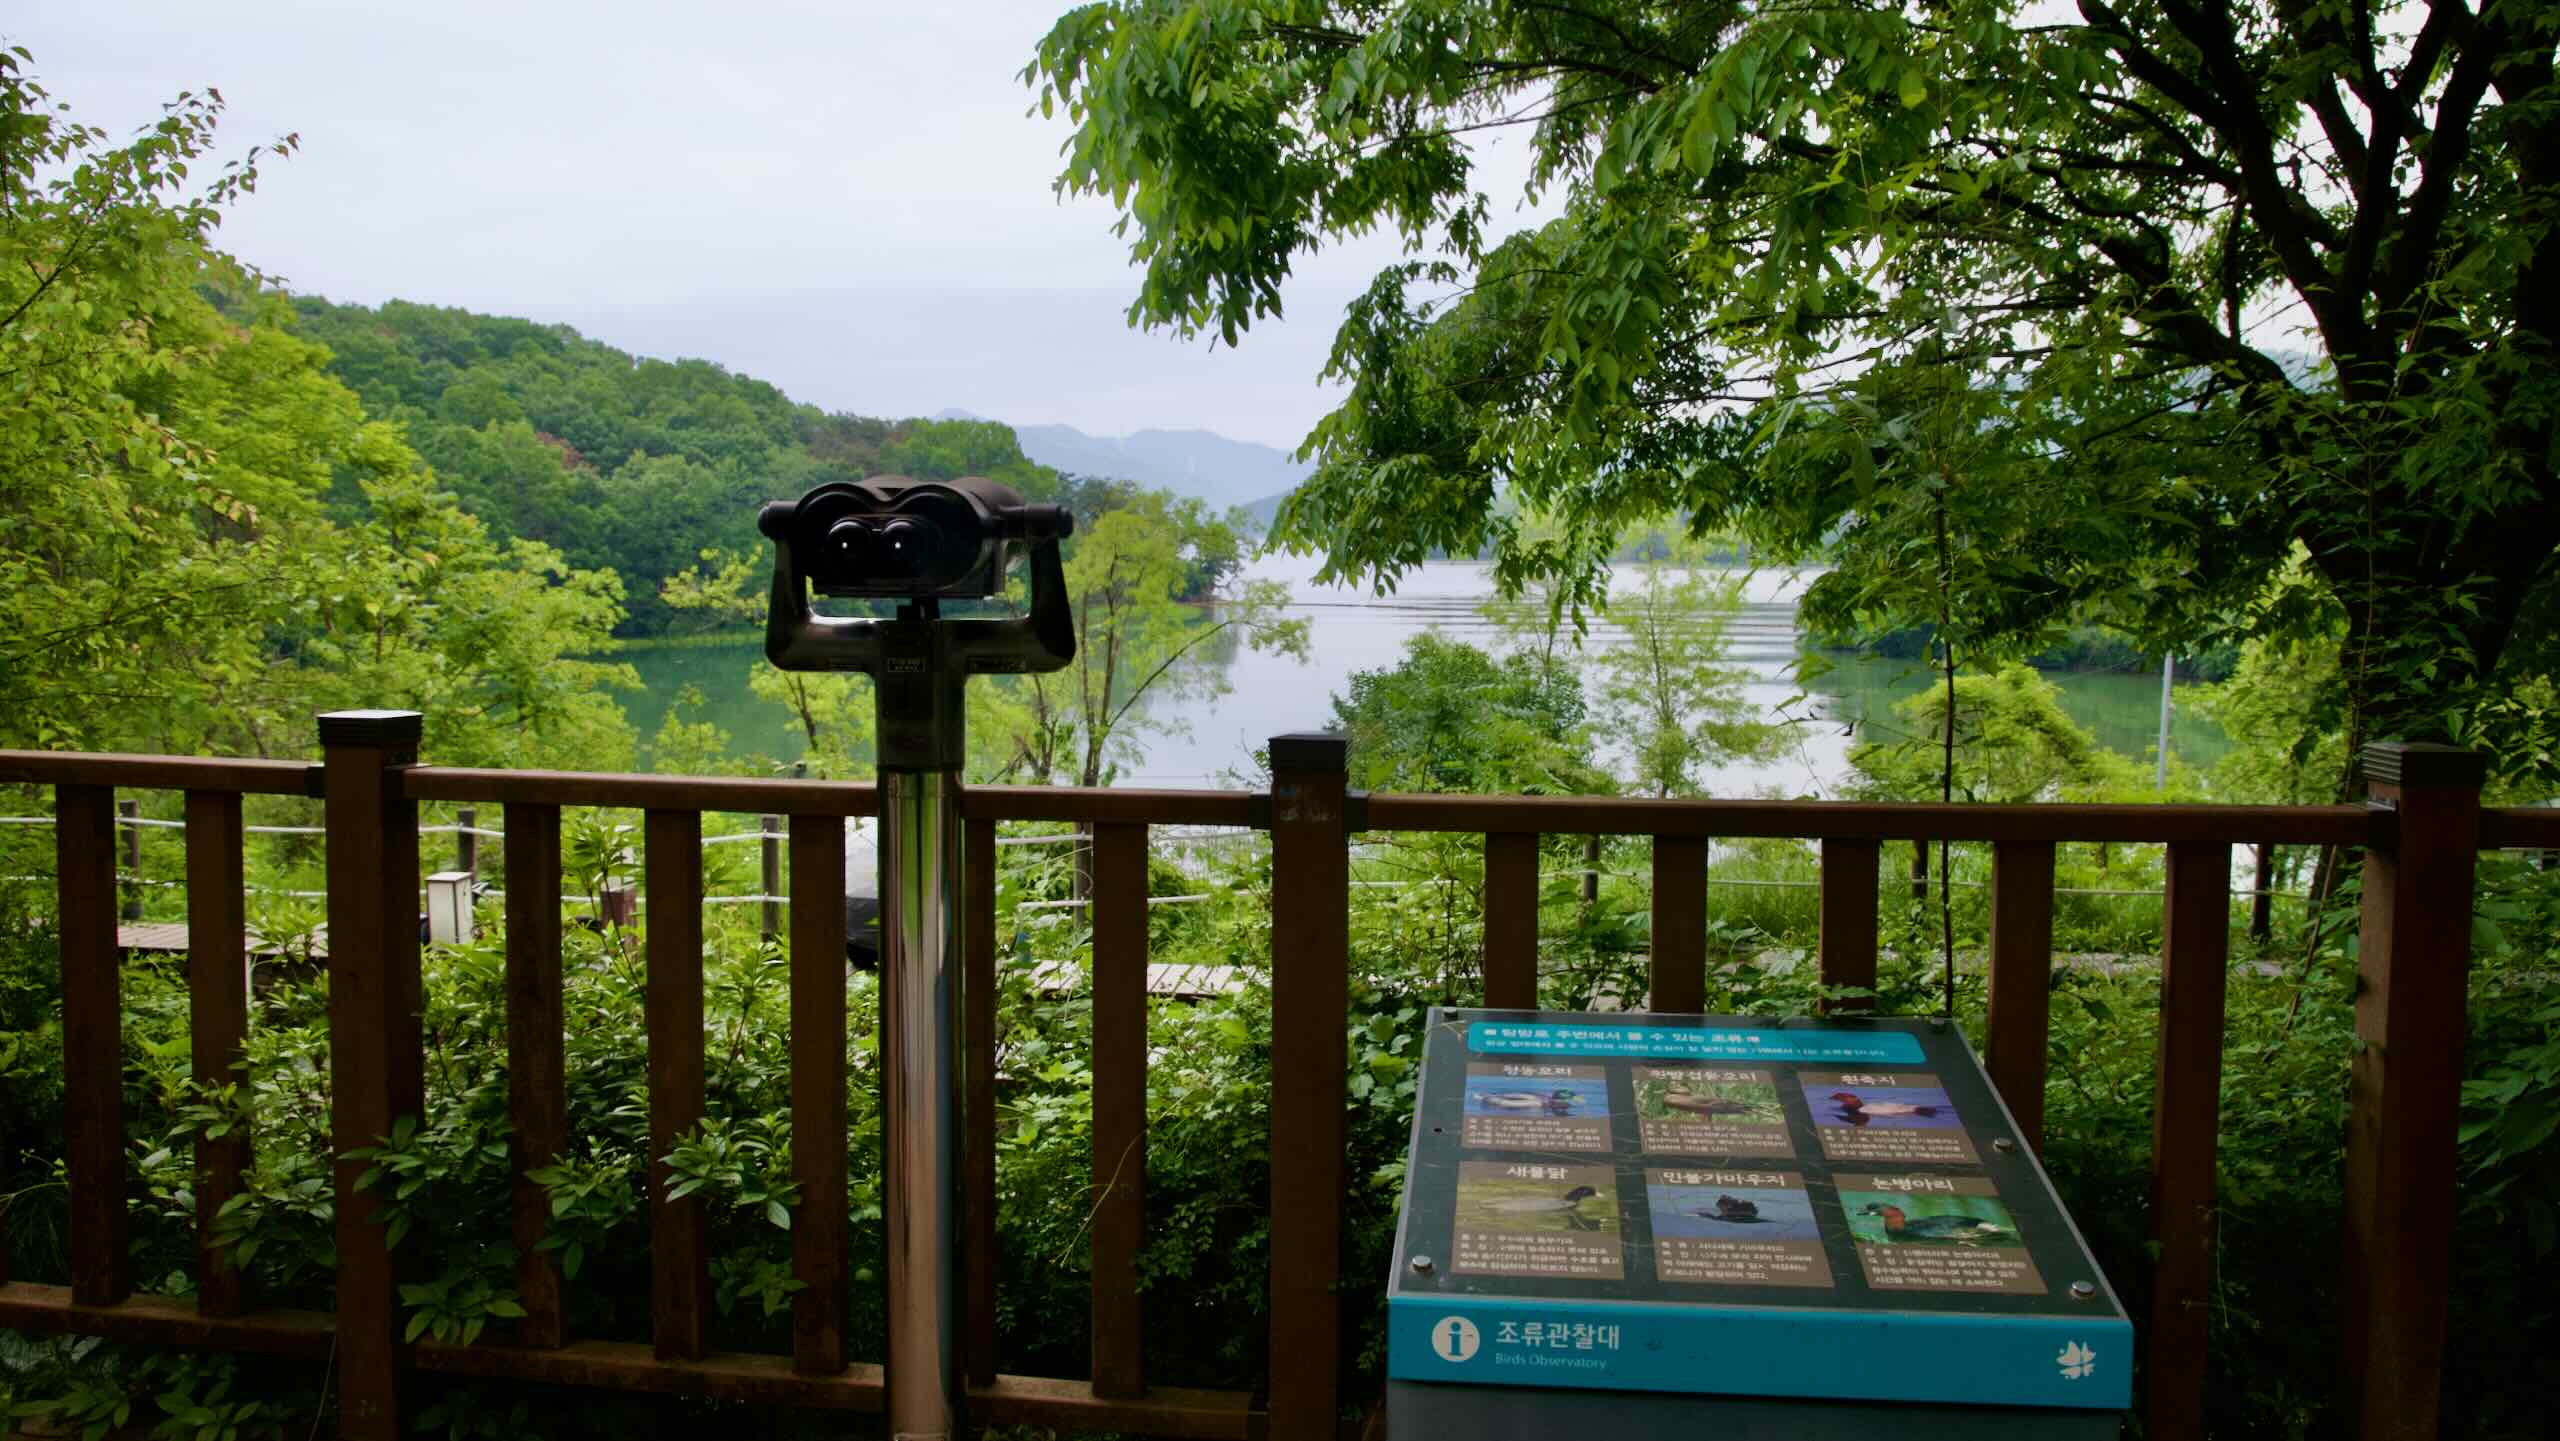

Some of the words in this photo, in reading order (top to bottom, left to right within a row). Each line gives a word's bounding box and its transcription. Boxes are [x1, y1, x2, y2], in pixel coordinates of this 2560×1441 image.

[1663, 1171, 1785, 1186] 민물가마우지
[1872, 1177, 1954, 1192] 논병아리
[1496, 1321, 1620, 1350] 조류관찰대
[1496, 1353, 1526, 1365] Birds
[1529, 1354, 1607, 1369] Observatory
